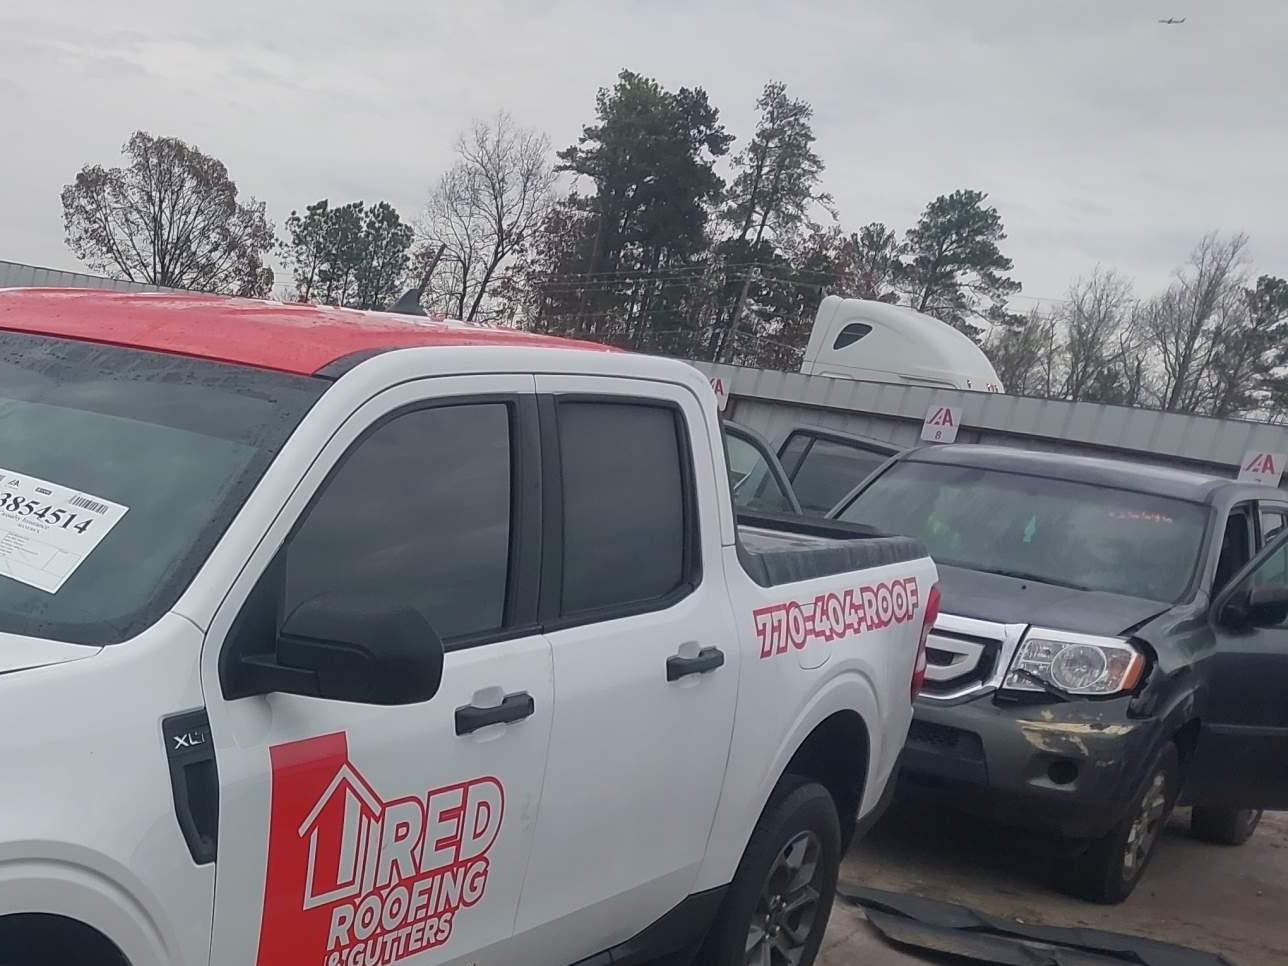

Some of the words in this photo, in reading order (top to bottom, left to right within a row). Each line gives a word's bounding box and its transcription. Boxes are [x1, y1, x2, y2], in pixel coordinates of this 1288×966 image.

[753, 577, 919, 659] 770-404-ROOF
[374, 778, 504, 889] RED
[326, 859, 489, 951] ROOFING
